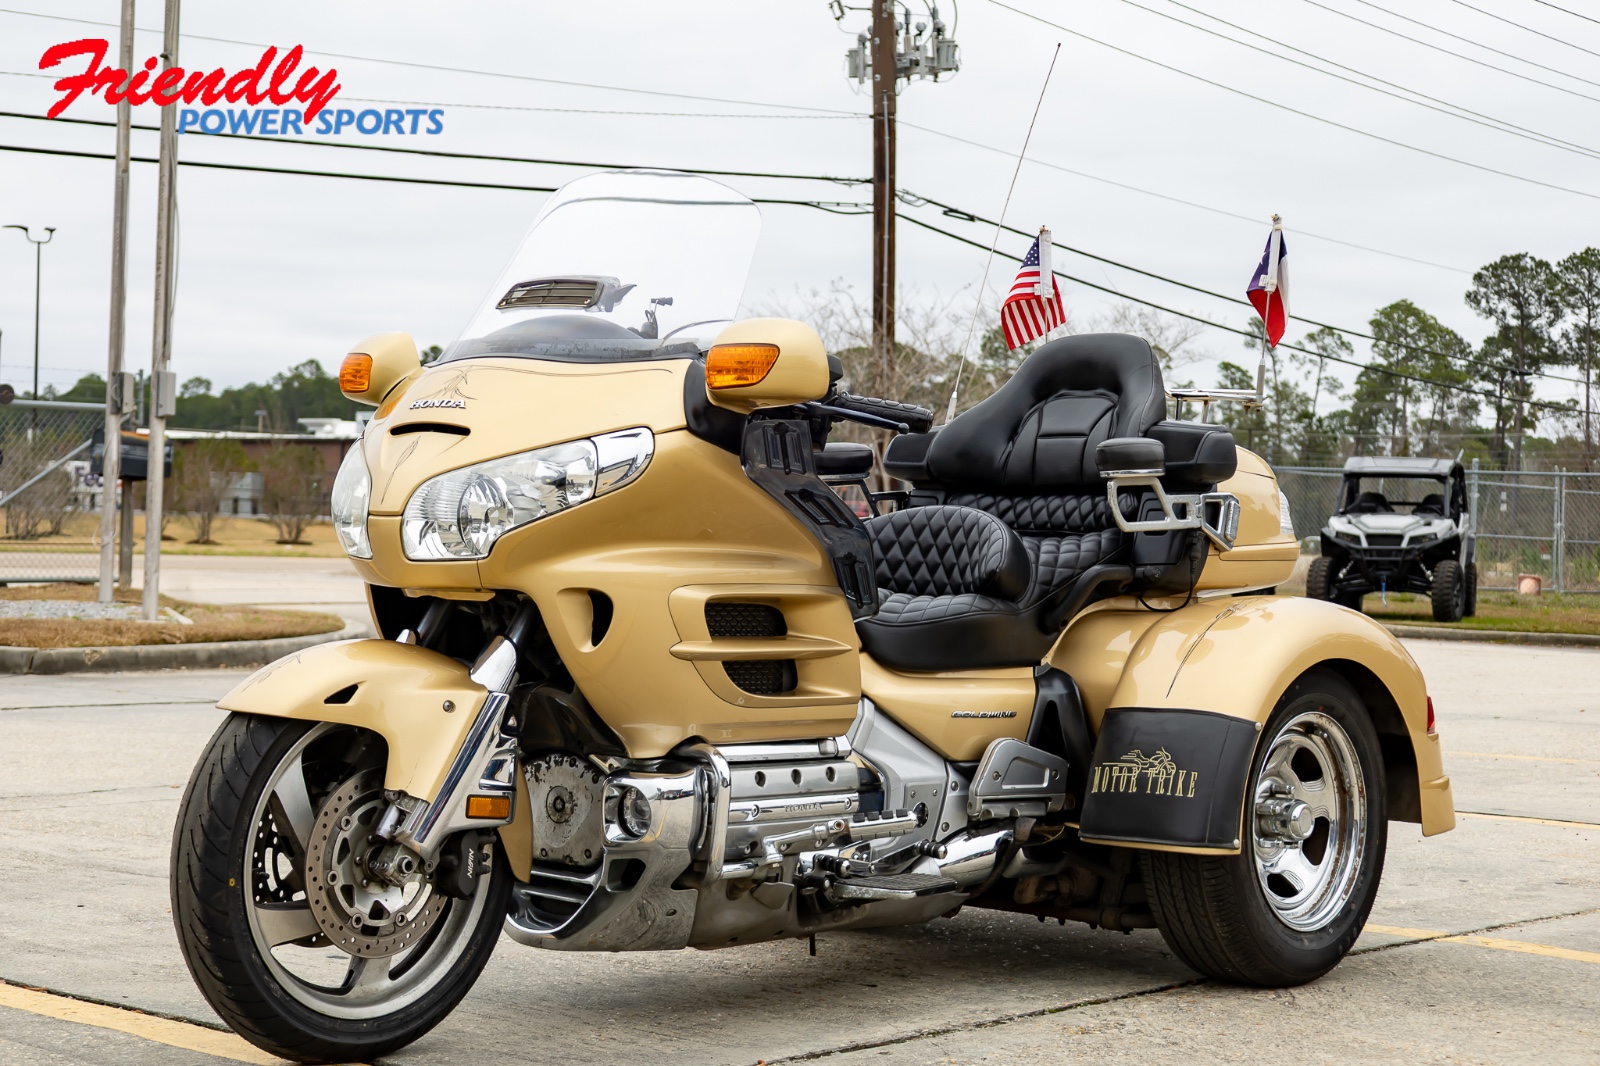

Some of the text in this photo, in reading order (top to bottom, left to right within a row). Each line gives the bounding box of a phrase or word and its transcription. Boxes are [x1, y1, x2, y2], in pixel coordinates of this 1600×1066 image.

[409, 399, 466, 410] HONDA
[1091, 766, 1198, 797] MOTOR TRIKE
[784, 802, 823, 812] HONDA
